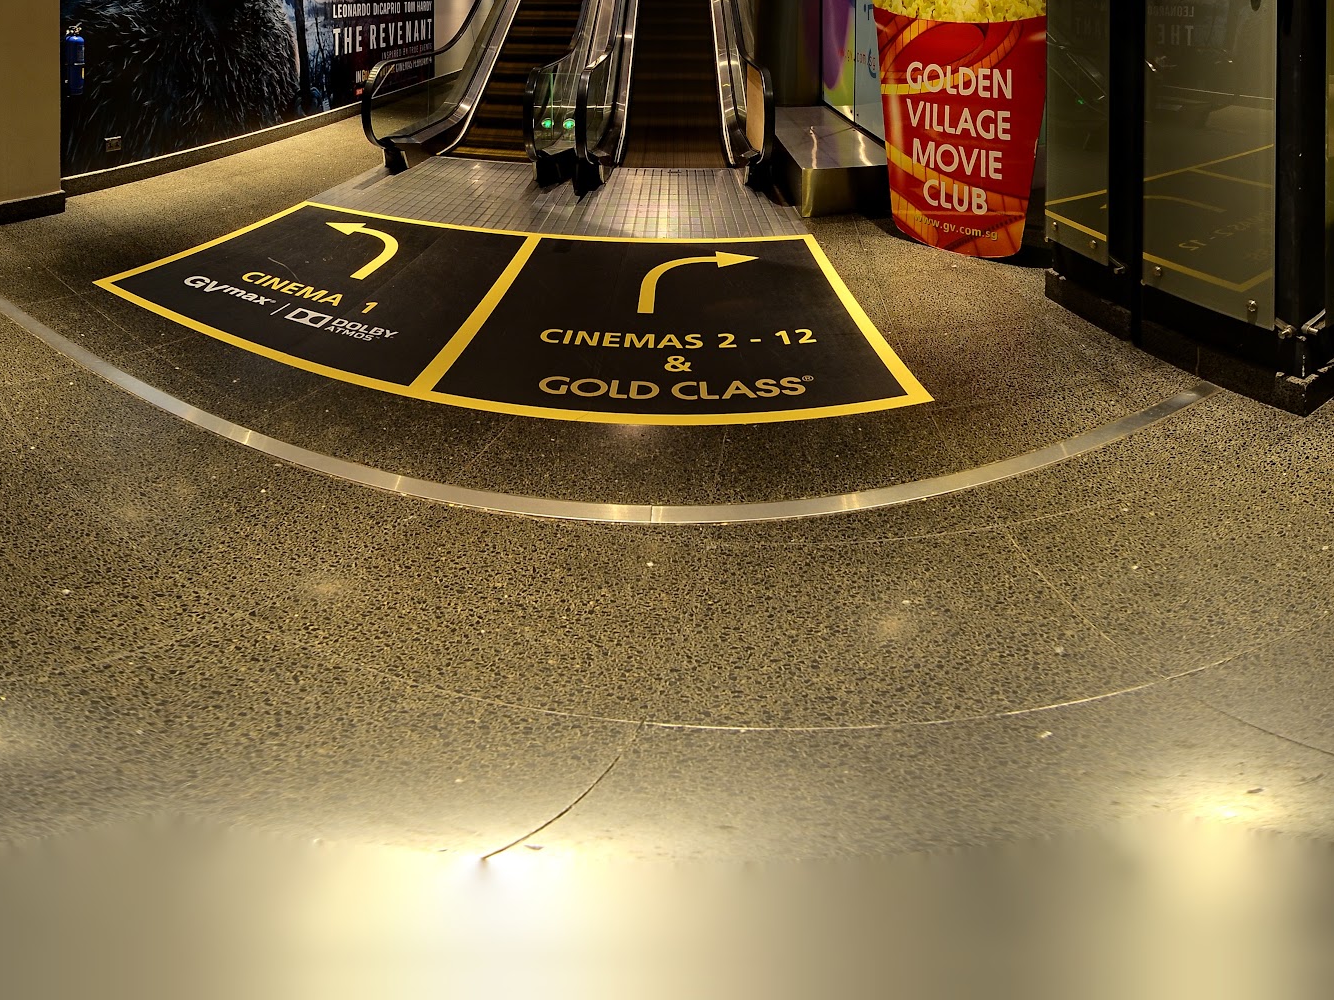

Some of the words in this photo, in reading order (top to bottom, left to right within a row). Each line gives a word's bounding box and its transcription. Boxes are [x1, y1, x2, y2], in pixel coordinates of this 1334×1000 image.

[332, 3, 370, 18] LEONARDO
[373, 2, 400, 15] DiCAPRIO
[404, 1, 415, 13] TOM
[416, 1, 432, 12] HARDY
[332, 25, 363, 56] THE
[369, 18, 432, 50] REVENANT
[381, 49, 402, 60] INSPIRED
[408, 45, 419, 54] TRUE
[419, 43, 432, 52] EVENTS
[355, 71, 361, 83] IN
[906, 61, 1012, 99] GOLDEN
[906, 99, 1011, 141] VILLAGE
[912, 137, 1003, 180] MOVIE
[923, 179, 988, 215] CLUB
[914, 215, 999, 240] www.gv.com.sg
[241, 271, 344, 307] CINEMA
[361, 301, 378, 314] 1
[332, 318, 398, 338] DOLBY
[540, 328, 704, 349] CINEMAS
[717, 333, 737, 348] 2
[775, 328, 817, 345] 12
[664, 355, 692, 372] &
[538, 376, 660, 400] GOLD
